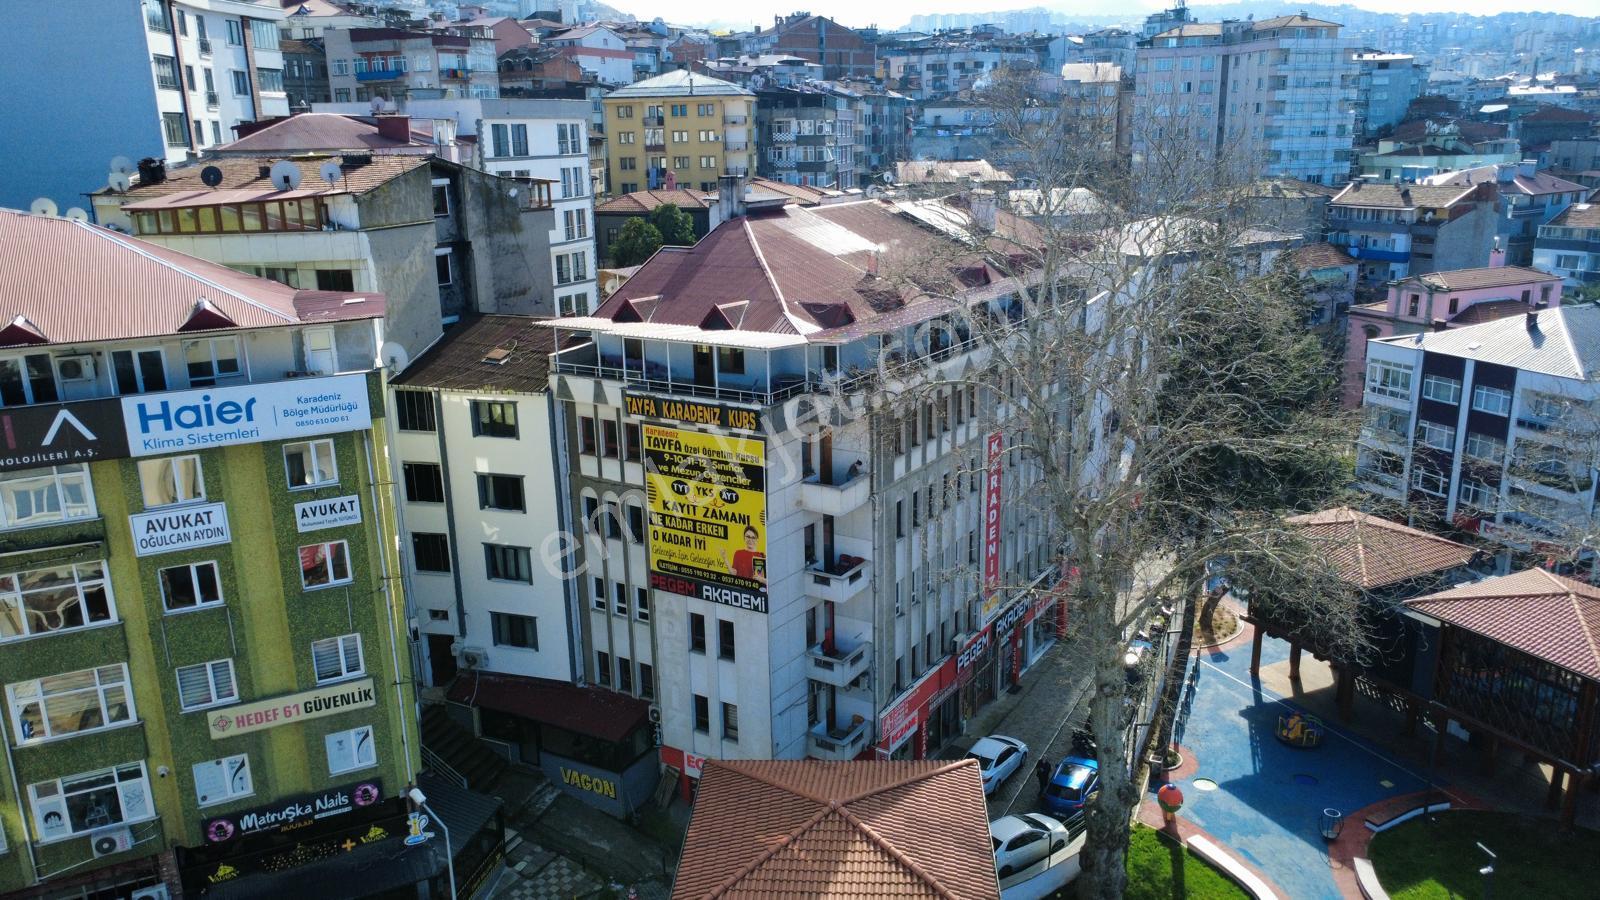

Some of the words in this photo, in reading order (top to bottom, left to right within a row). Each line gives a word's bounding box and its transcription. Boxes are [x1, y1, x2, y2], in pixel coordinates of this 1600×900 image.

[297, 392, 341, 404] Karadeniz
[137, 395, 256, 434] Haier
[283, 408, 309, 418] Bölge
[311, 402, 358, 414] Müdürlüğü
[625, 396, 656, 417] TAYFA
[662, 401, 720, 425] KARADENİZ
[728, 409, 756, 430] KURS
[296, 419, 314, 427] 0850
[143, 437, 184, 450] Klima
[188, 427, 260, 445] Sistemleri
[646, 436, 682, 452] TAYFA
[684, 444, 700, 456] Özel
[702, 447, 733, 460] Öğretim
[74, 448, 99, 457] A.Ş.
[658, 464, 669, 472] ve
[670, 464, 701, 478] Mezun
[672, 483, 689, 494] TYT
[696, 485, 714, 498] YKS
[721, 488, 737, 502] AYT
[301, 500, 355, 519] AVUKAT
[662, 500, 697, 516] KAYIT
[146, 511, 213, 534] AVUKAT
[651, 513, 663, 525] NE
[665, 516, 694, 531] KADAR
[696, 522, 724, 537] ERKEN
[140, 532, 191, 549] OĞULCAN
[194, 526, 225, 541] AYDIN
[653, 530, 659, 541] O
[662, 533, 691, 548] KADAR
[694, 536, 706, 551] İYİ
[651, 574, 696, 596] PEGEM
[702, 585, 765, 612] AKADEMİ
[957, 630, 989, 673] PEGEM
[235, 708, 279, 728] HEDEF
[283, 703, 301, 718] 61
[304, 687, 373, 714] GÜVENLİK
[560, 766, 616, 798] VAGON
[315, 792, 349, 813] Nails
